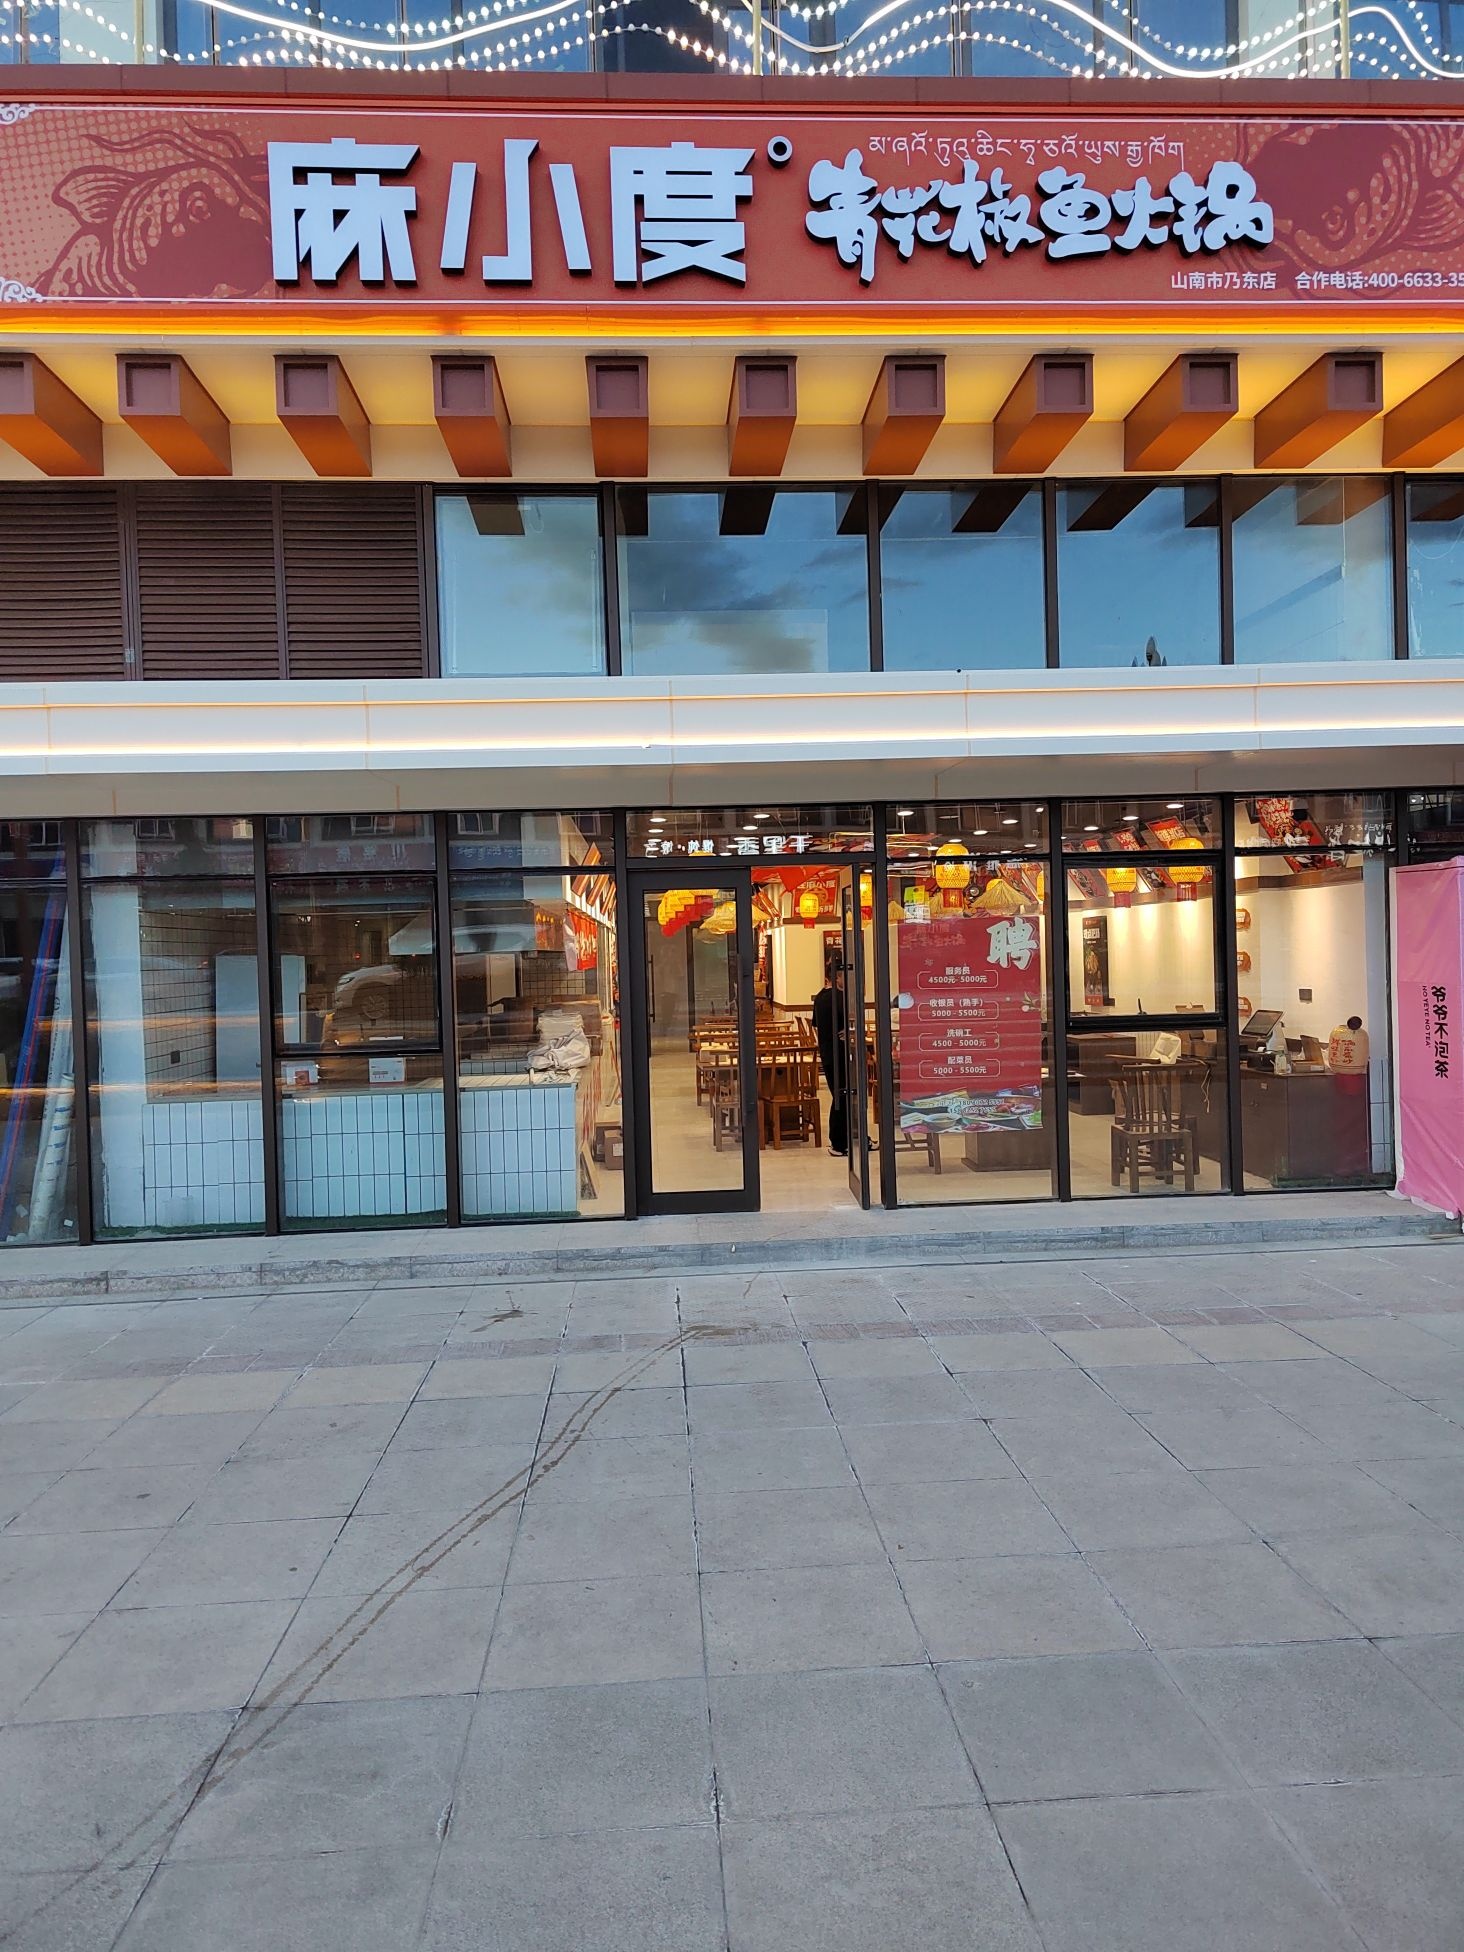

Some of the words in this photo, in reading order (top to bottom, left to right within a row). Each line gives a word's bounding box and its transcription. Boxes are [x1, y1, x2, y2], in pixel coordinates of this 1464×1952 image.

[266, 136, 758, 287] 麻小度
[804, 147, 1275, 285] 青花椒鱼火锅
[1170, 271, 1277, 289] 山南市乃东店
[986, 916, 1039, 971] 聘
[945, 966, 971, 976] 服务员
[1422, 985, 1428, 998] NO
[1424, 1019, 1431, 1031] NO
[1431, 985, 1449, 1079] 爷爷不泡茶
